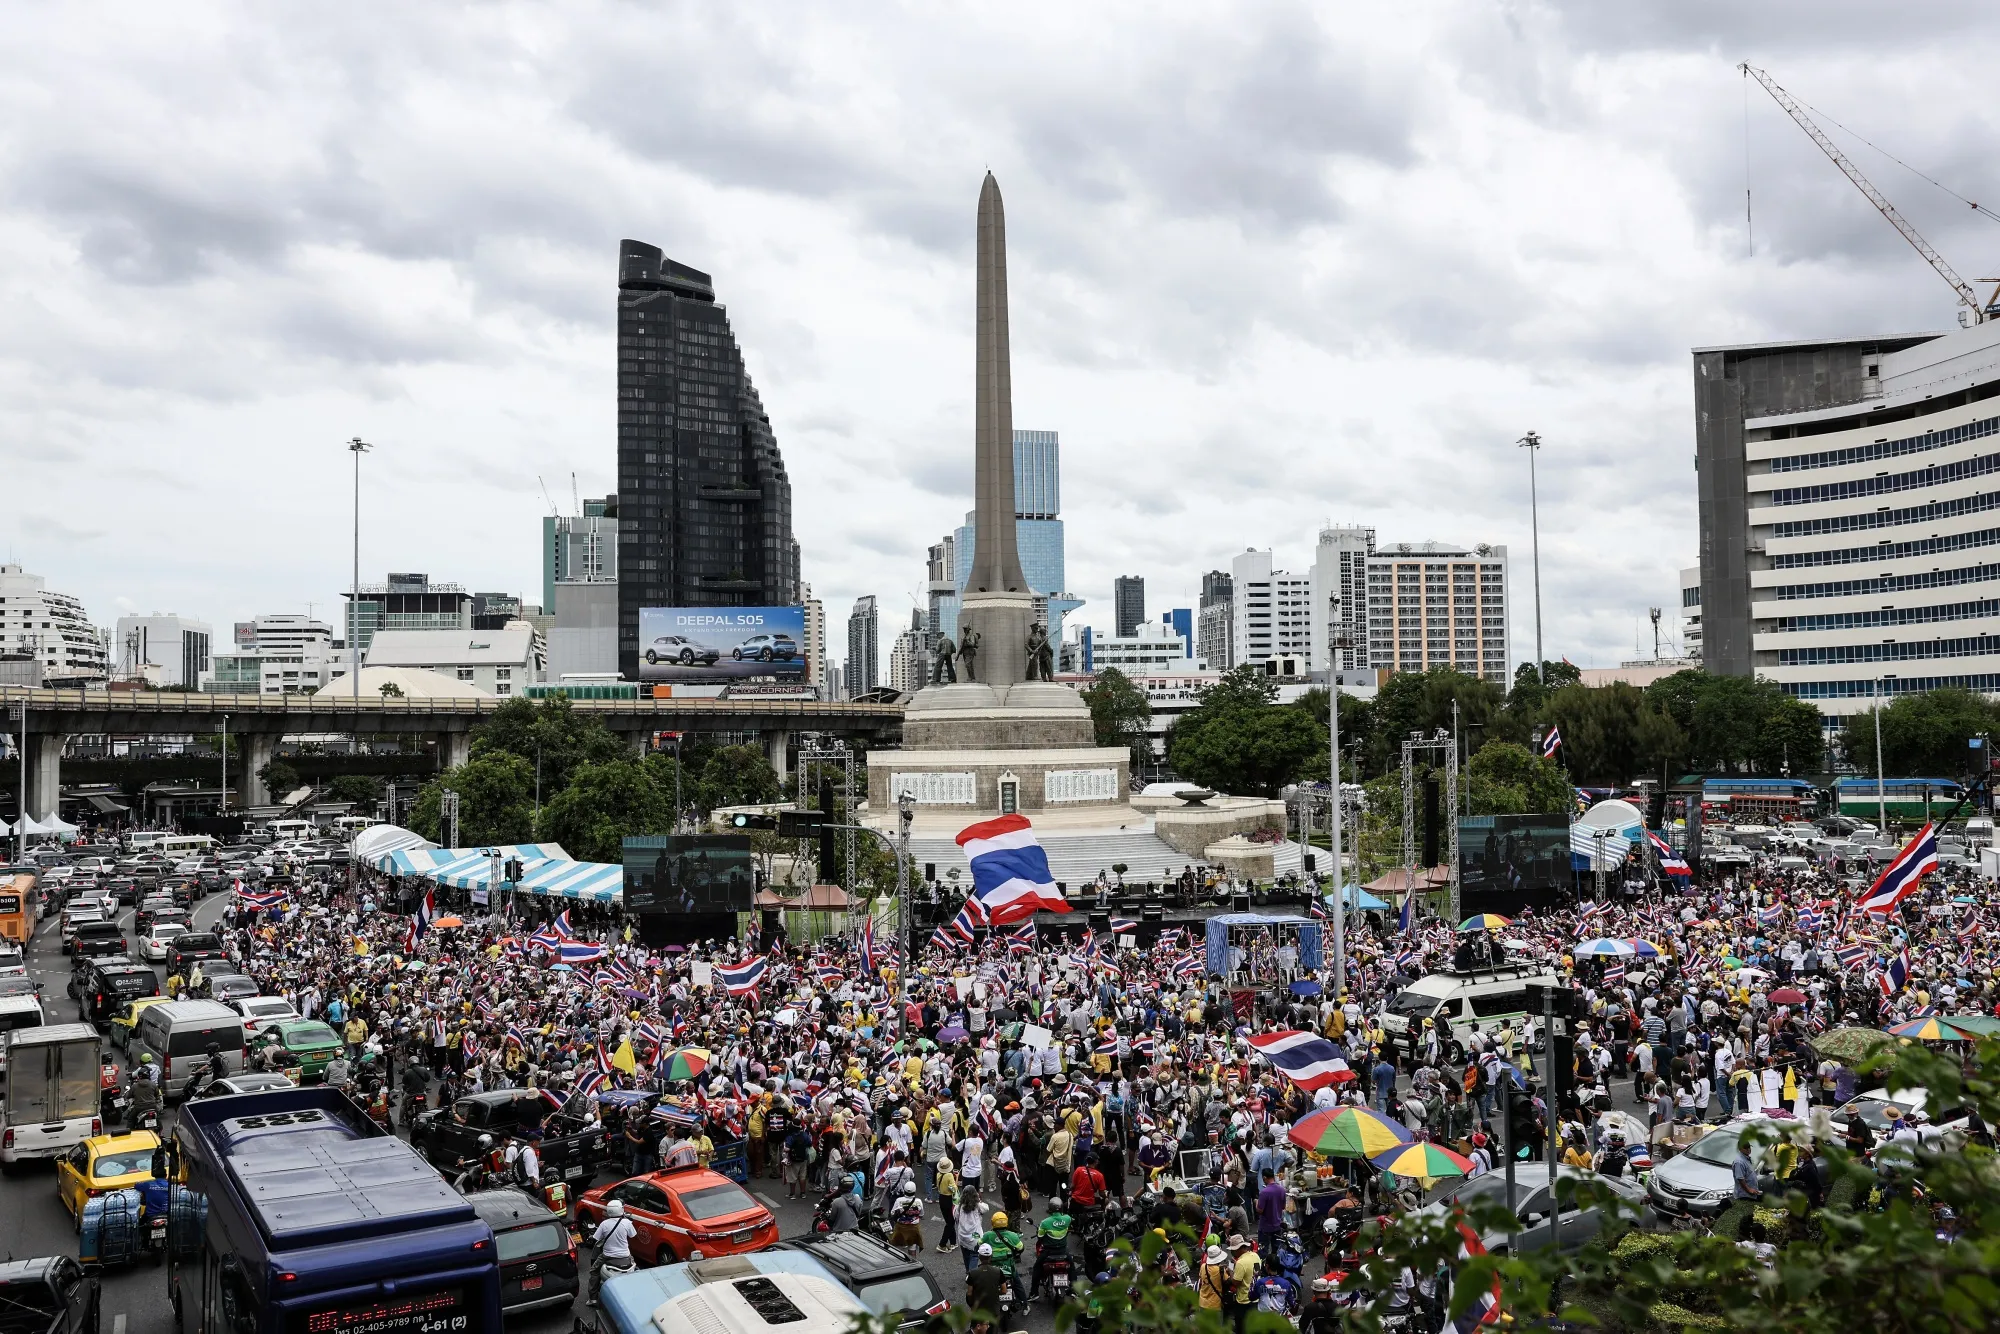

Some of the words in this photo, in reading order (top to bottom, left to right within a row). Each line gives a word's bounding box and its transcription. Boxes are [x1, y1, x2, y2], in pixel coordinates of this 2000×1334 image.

[677, 615, 733, 626] DEEPAL
[737, 615, 764, 625] S05
[558, 1200, 563, 1209] 1
[353, 1318, 410, 1334] 02-405-9789
[428, 1313, 433, 1321] 1
[421, 1319, 448, 1333] 4-61
[451, 1315, 467, 1331] (2)
